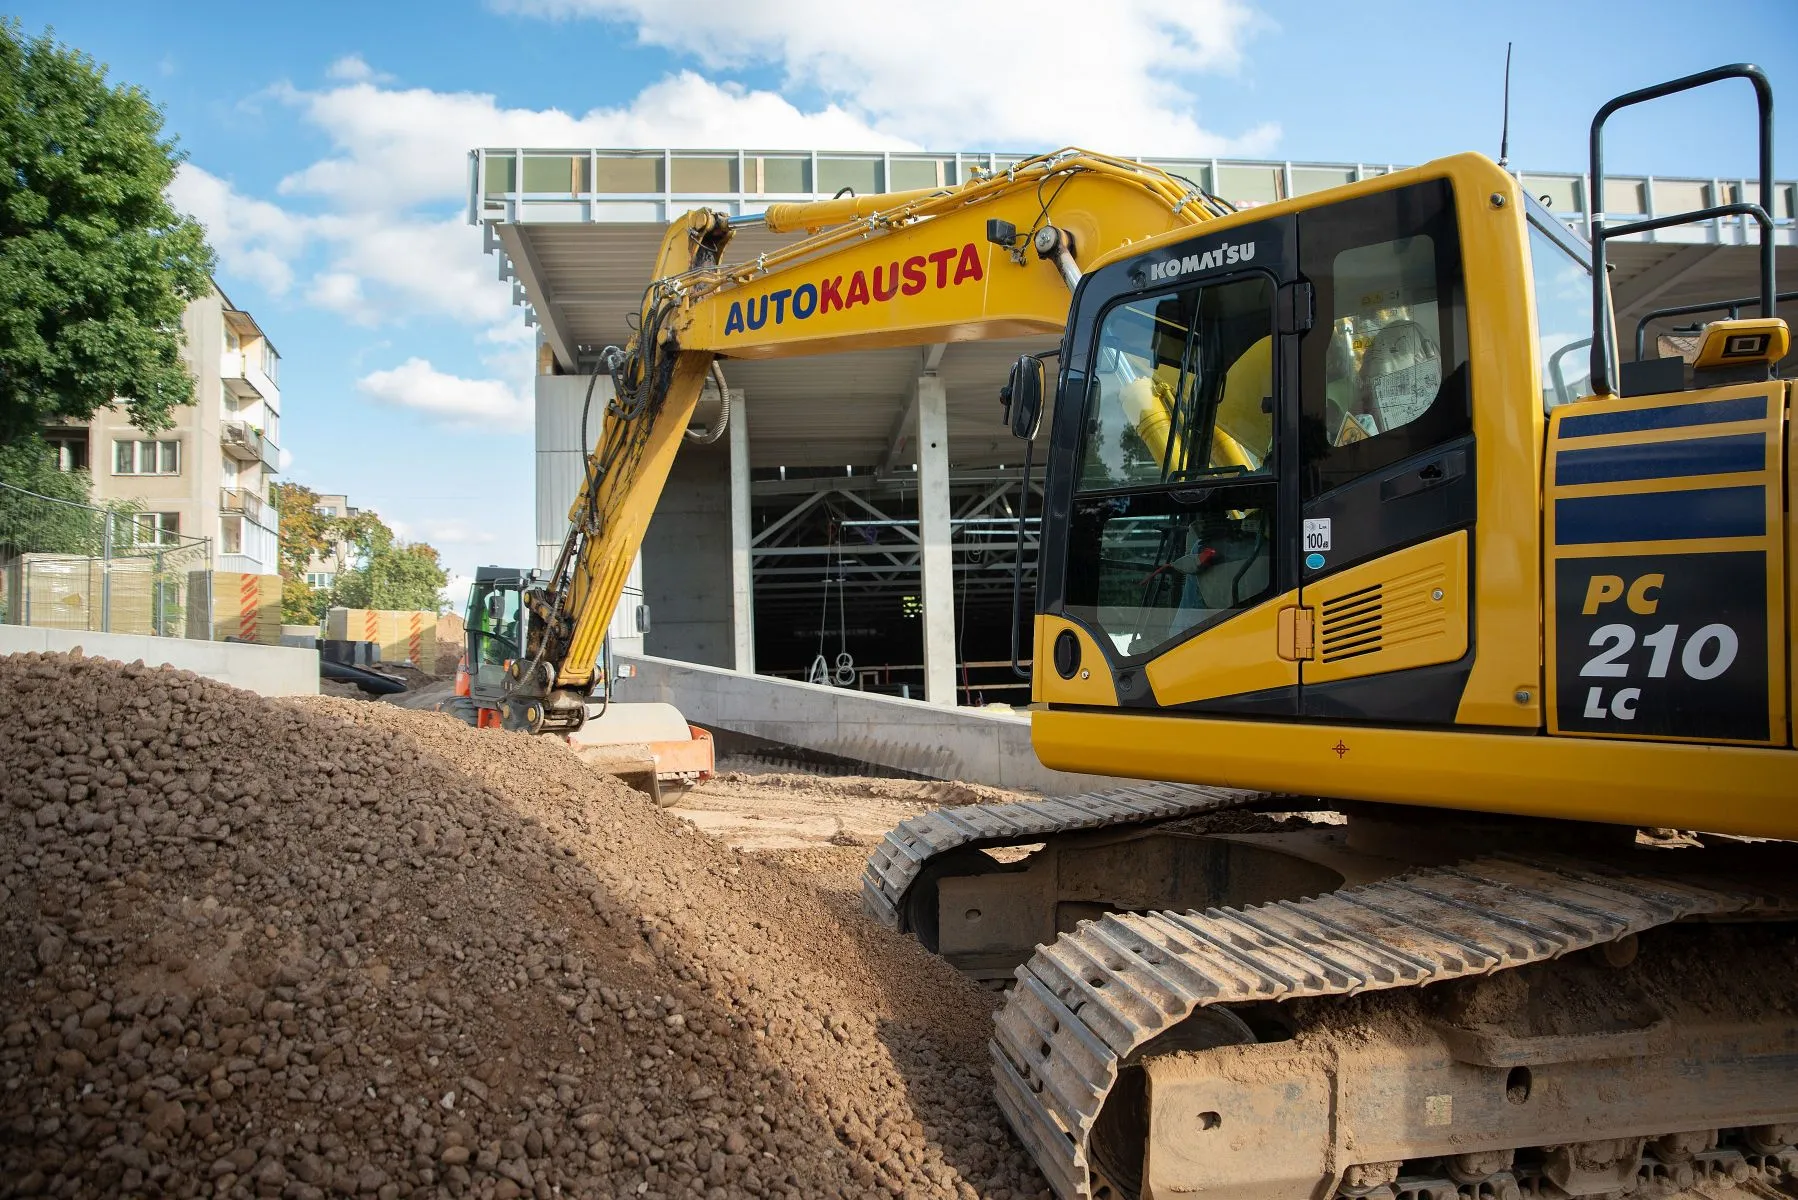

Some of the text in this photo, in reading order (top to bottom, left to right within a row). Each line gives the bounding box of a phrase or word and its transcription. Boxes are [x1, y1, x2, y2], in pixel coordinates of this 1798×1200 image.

[1150, 241, 1255, 281] KOMATSU
[724, 243, 983, 336] AUTOKAUSTA
[1307, 533, 1322, 548] 100
[1581, 573, 1665, 615] PC
[1579, 623, 1739, 681] 210
[1583, 686, 1641, 721] LC
